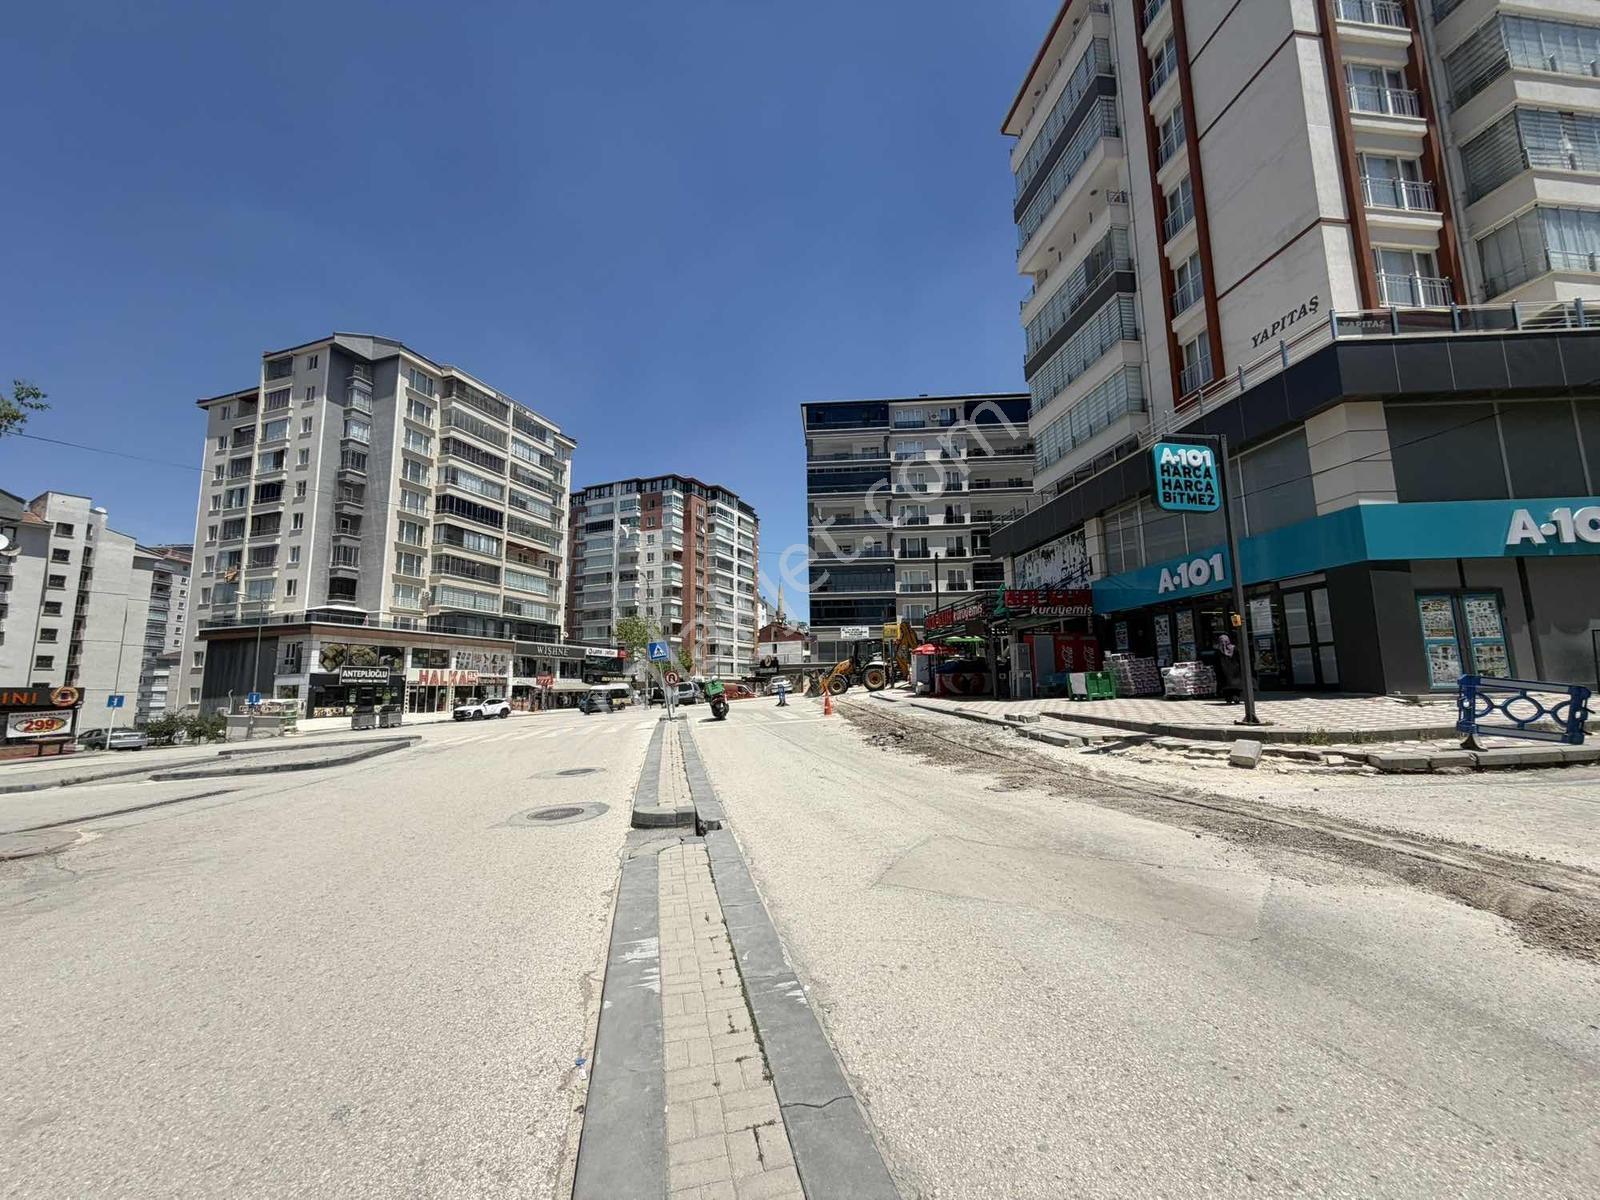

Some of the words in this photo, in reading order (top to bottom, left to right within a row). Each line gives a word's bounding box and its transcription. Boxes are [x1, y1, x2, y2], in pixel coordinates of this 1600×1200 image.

[1252, 295, 1319, 349] YAPITAŞ
[1161, 464, 1213, 480] HARCA
[1162, 478, 1214, 493] HARCA
[419, 670, 467, 686] HALKA
[24, 719, 56, 734] 299
